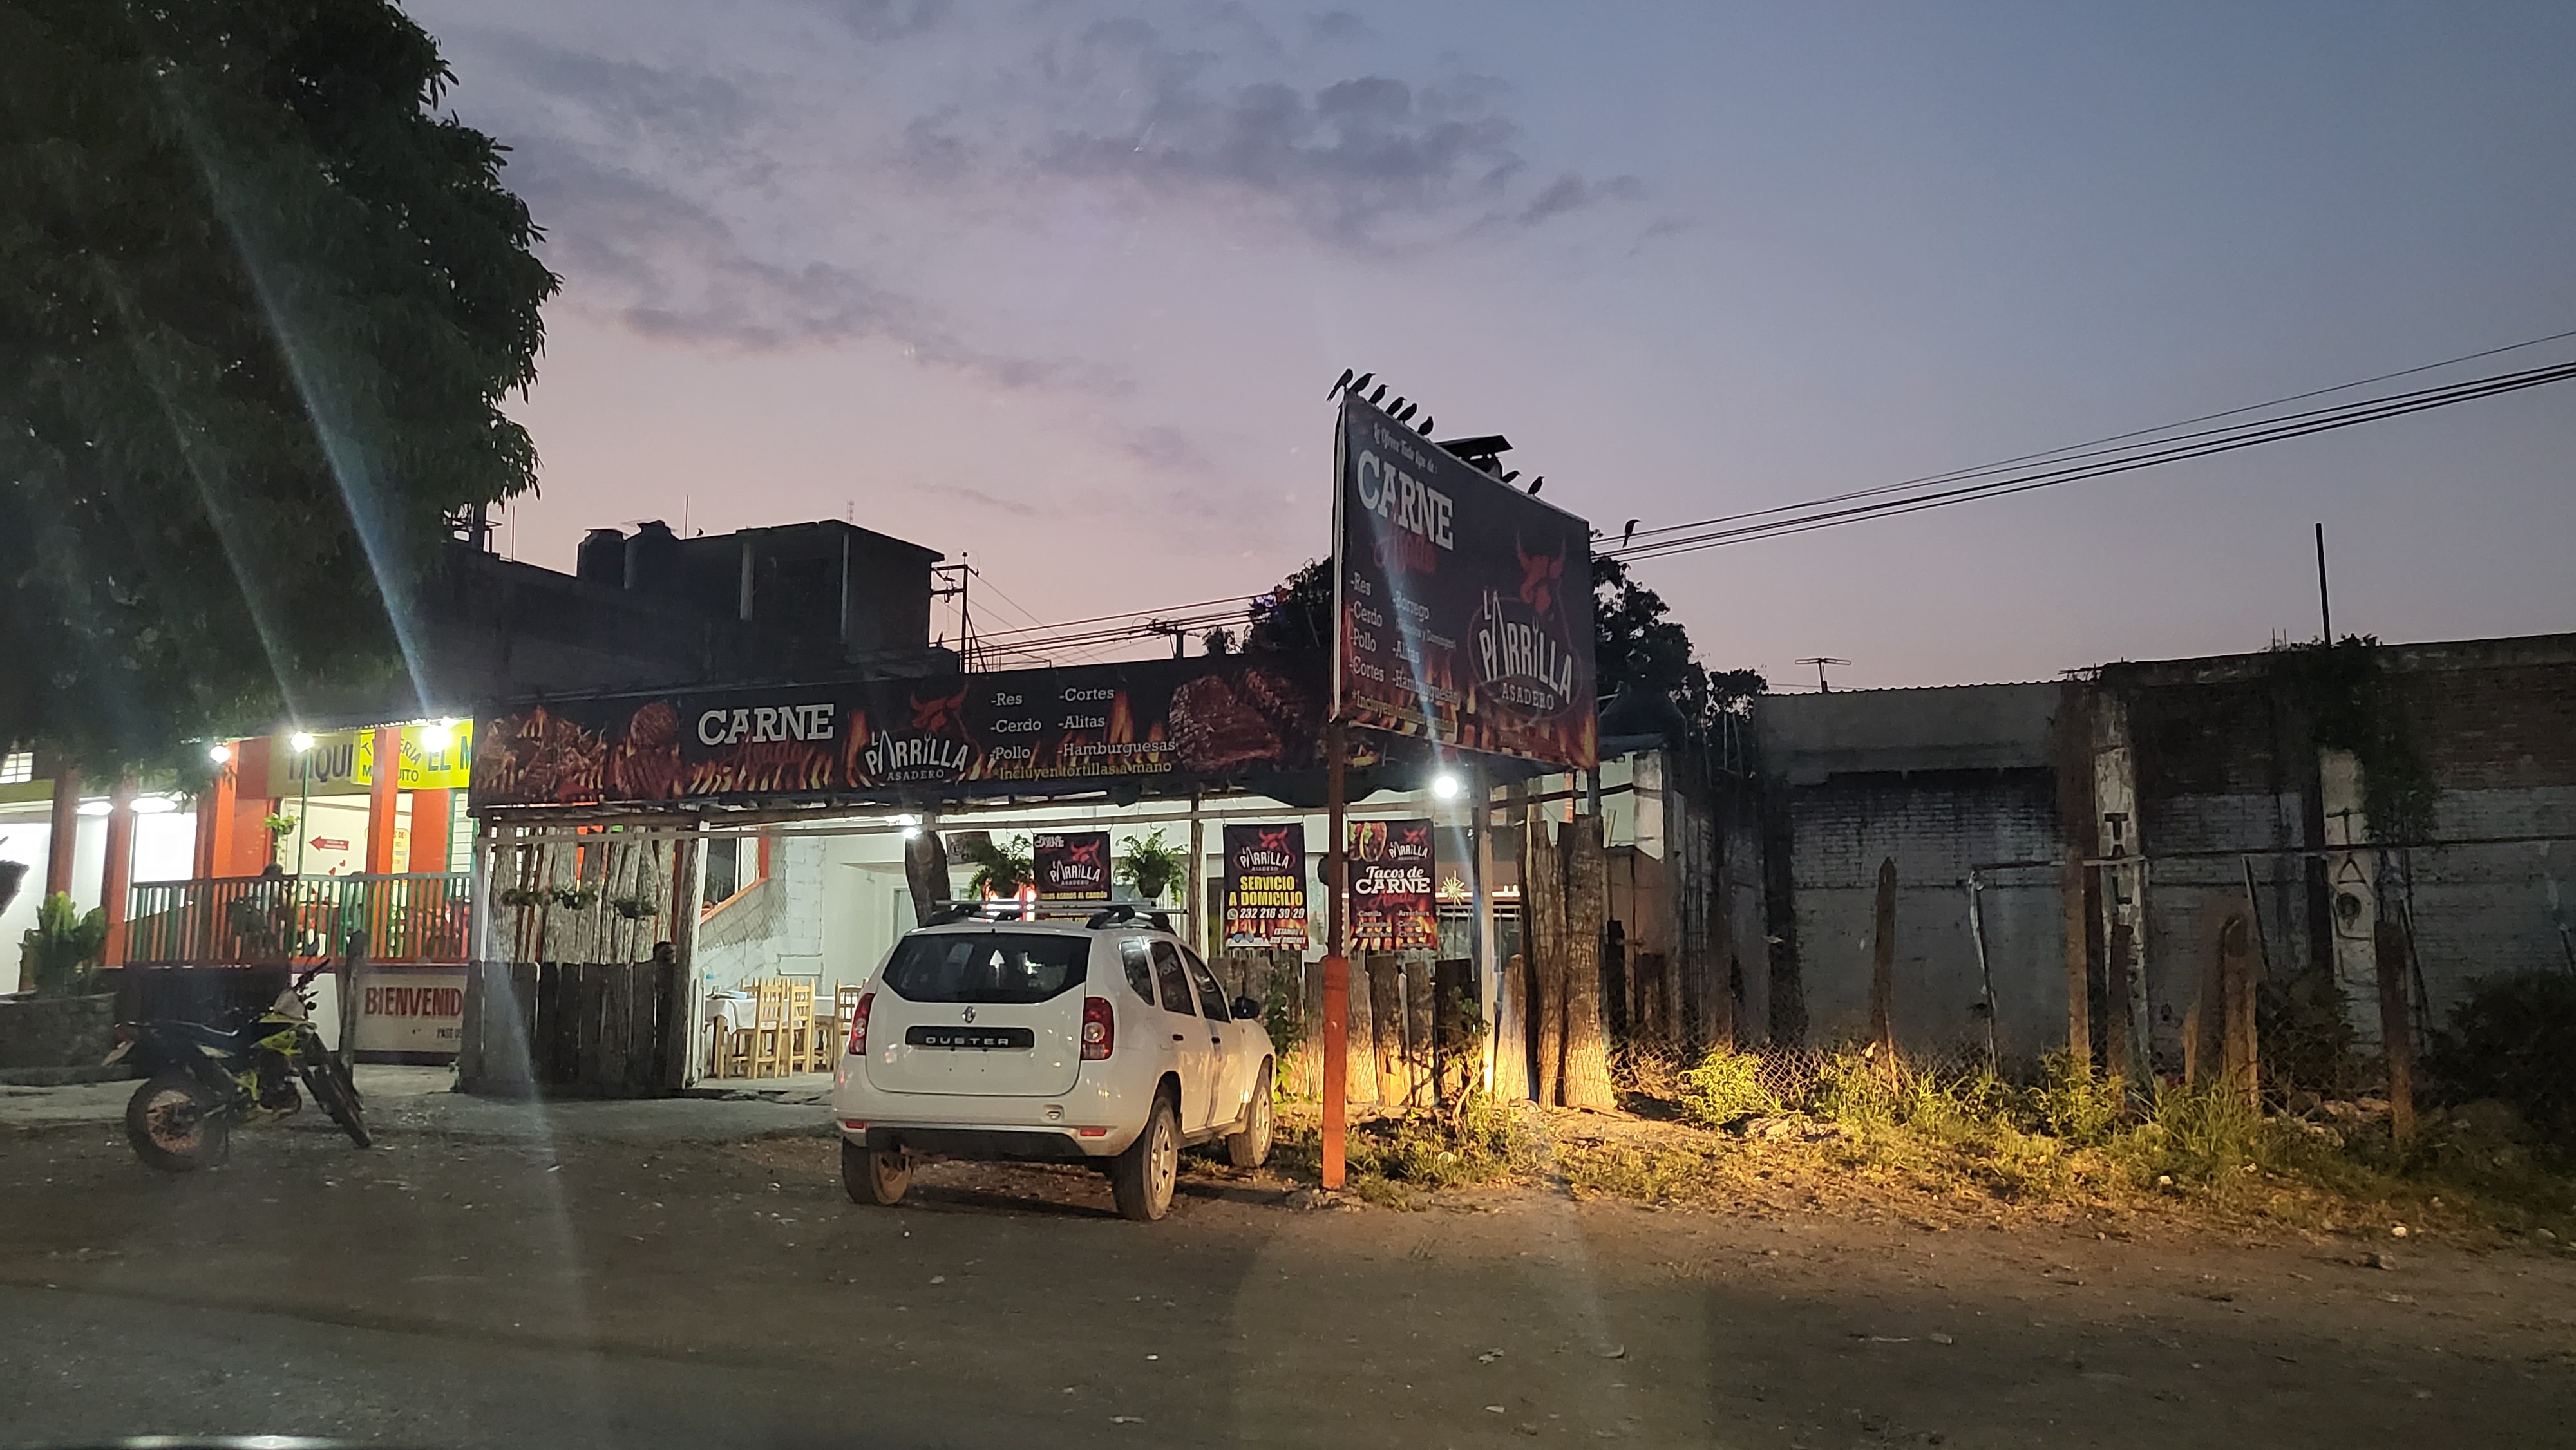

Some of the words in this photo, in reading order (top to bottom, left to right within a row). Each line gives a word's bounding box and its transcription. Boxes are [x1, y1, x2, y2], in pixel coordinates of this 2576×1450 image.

[1357, 449, 1454, 551] CARNE
[1479, 590, 1572, 704] PARRILLA
[1501, 682, 1555, 710] ASADERO
[698, 704, 834, 746] CARNE
[865, 730, 969, 776] PARRILLA
[887, 769, 945, 782] ASADERO
[1063, 763, 1116, 777] tortillas
[1132, 761, 1172, 774] mano
[1240, 846, 1289, 869] PARRILLA
[1388, 841, 1428, 859] PARRILLA
[1049, 860, 1101, 882] PARRILLA
[1366, 866, 1404, 879] Tacos
[1406, 865, 1424, 878] de
[1240, 876, 1294, 891] SERVICIO
[1355, 878, 1431, 894] CARNE
[1229, 892, 1237, 907] A
[1240, 891, 1303, 907] DOMICILIO
[1240, 908, 1258, 919] 232
[1259, 908, 1276, 919] 216
[365, 987, 462, 1016] BIENVENID
[925, 1037, 1009, 1046] DUSTER
